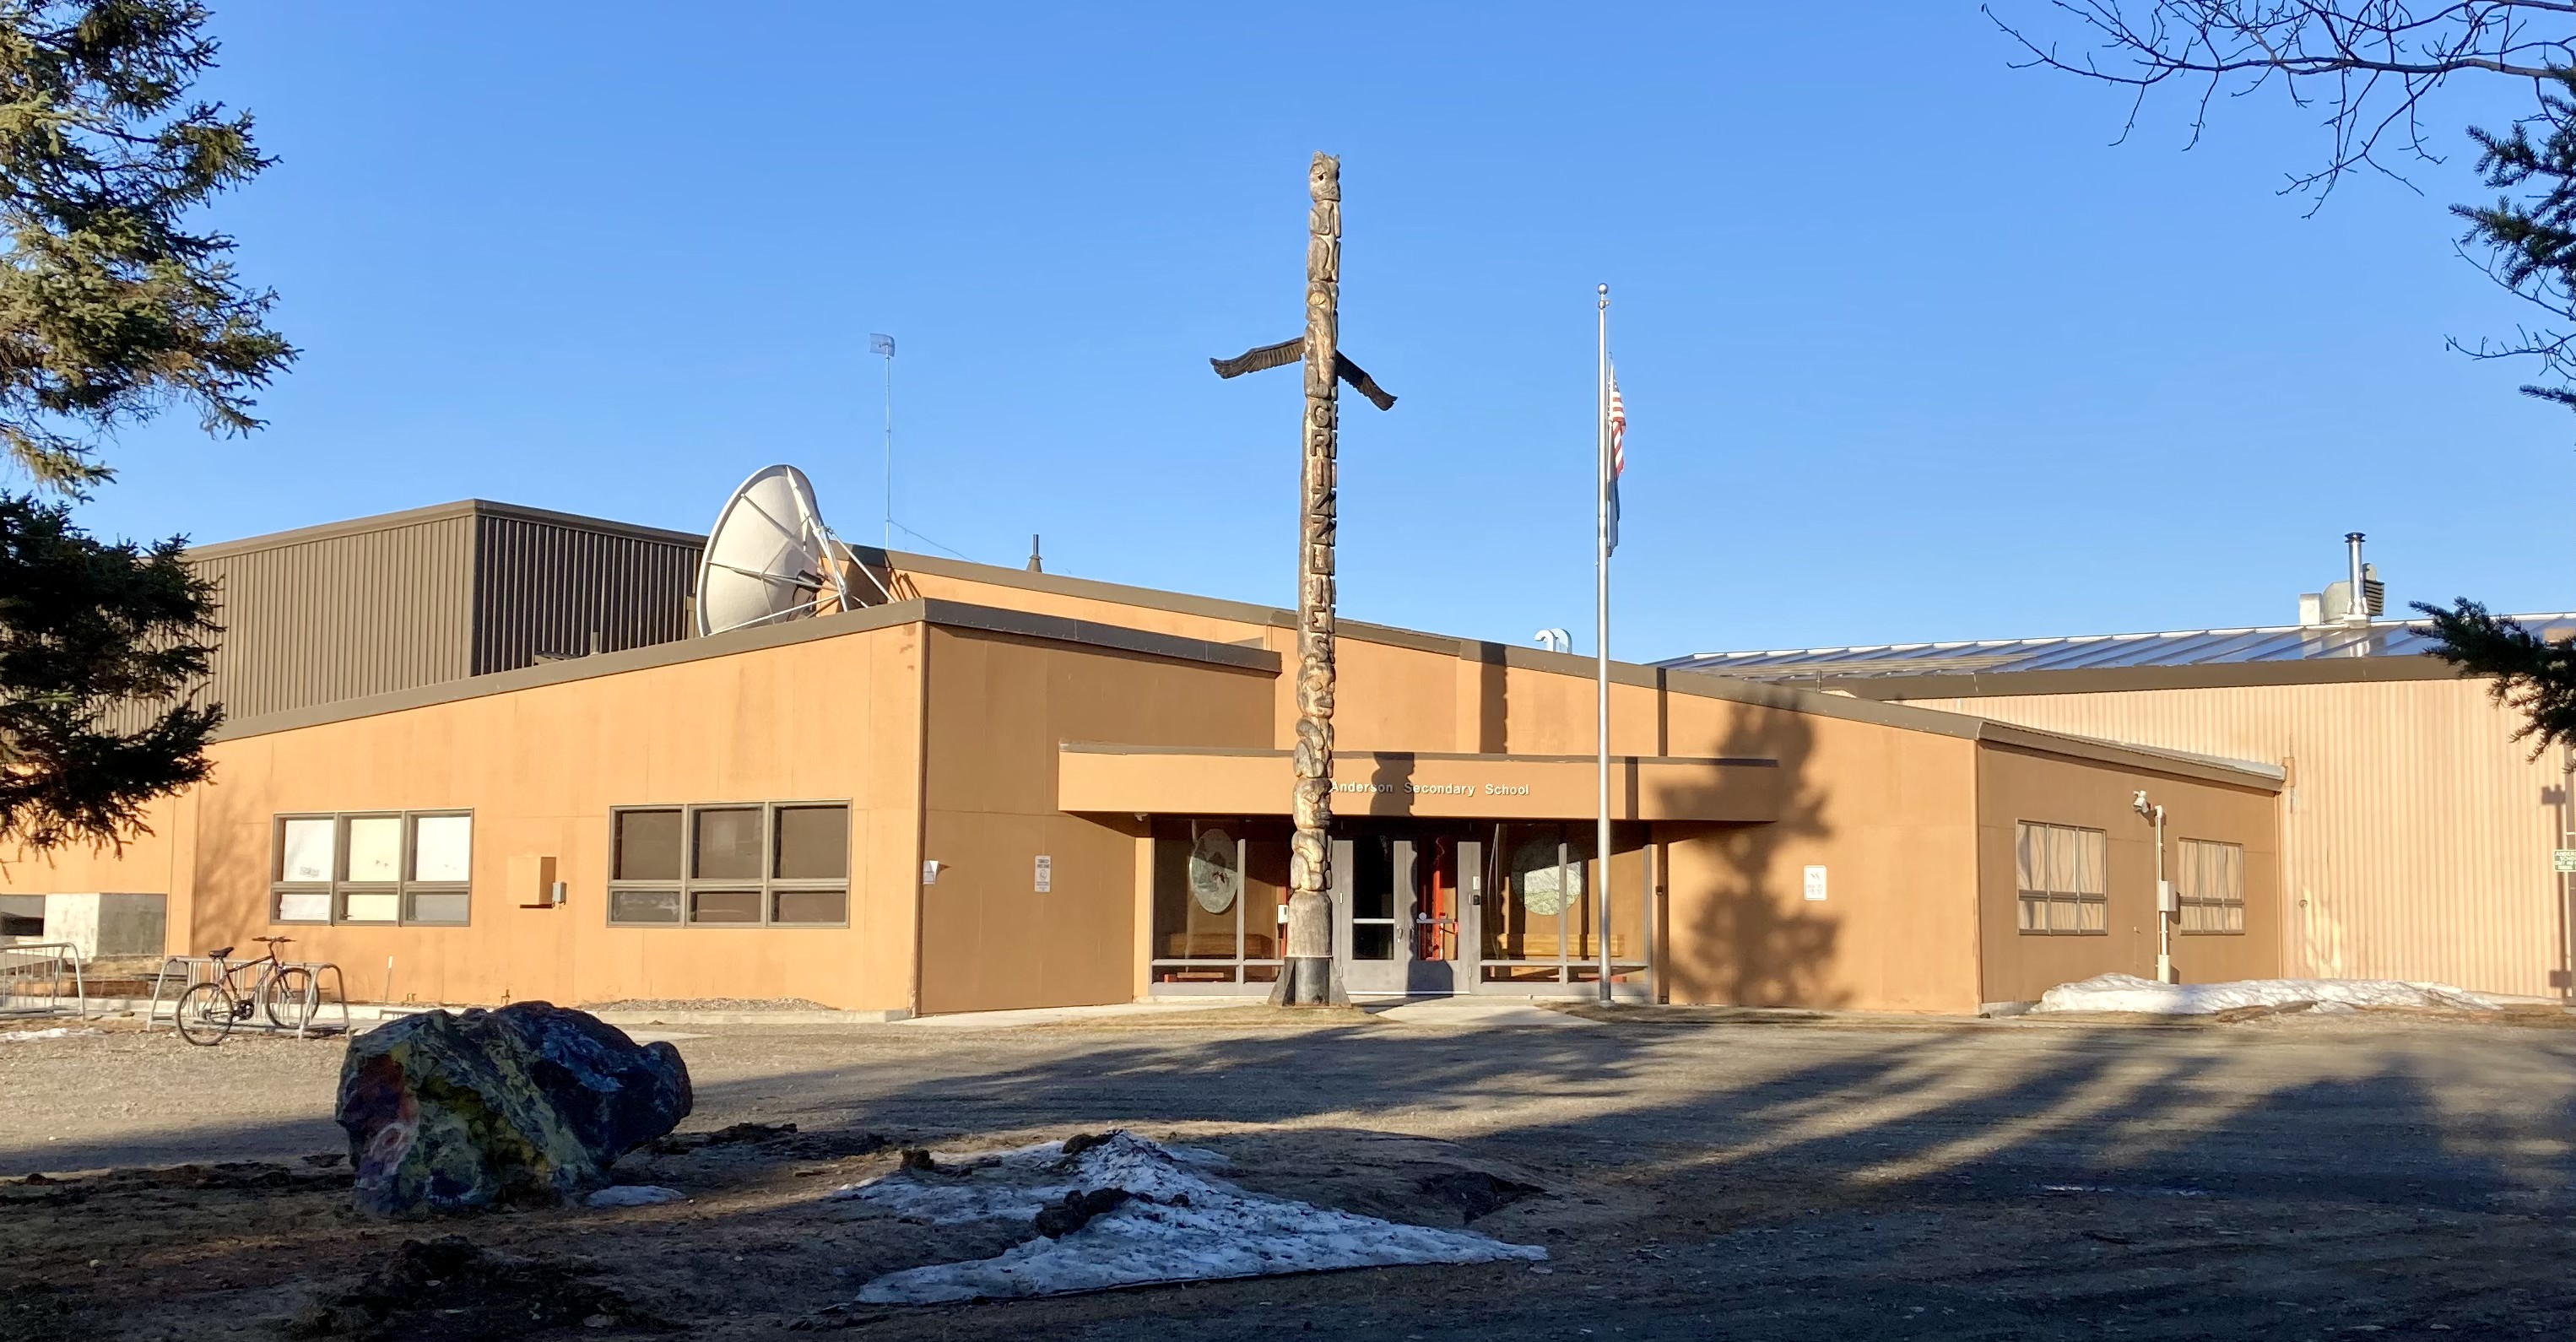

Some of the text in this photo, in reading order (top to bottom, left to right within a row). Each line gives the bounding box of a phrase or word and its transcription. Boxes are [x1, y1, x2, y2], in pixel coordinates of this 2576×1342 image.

[1308, 403, 1331, 663] GRIZZLIES
[1331, 781, 1529, 796] Anderson Secondary School
